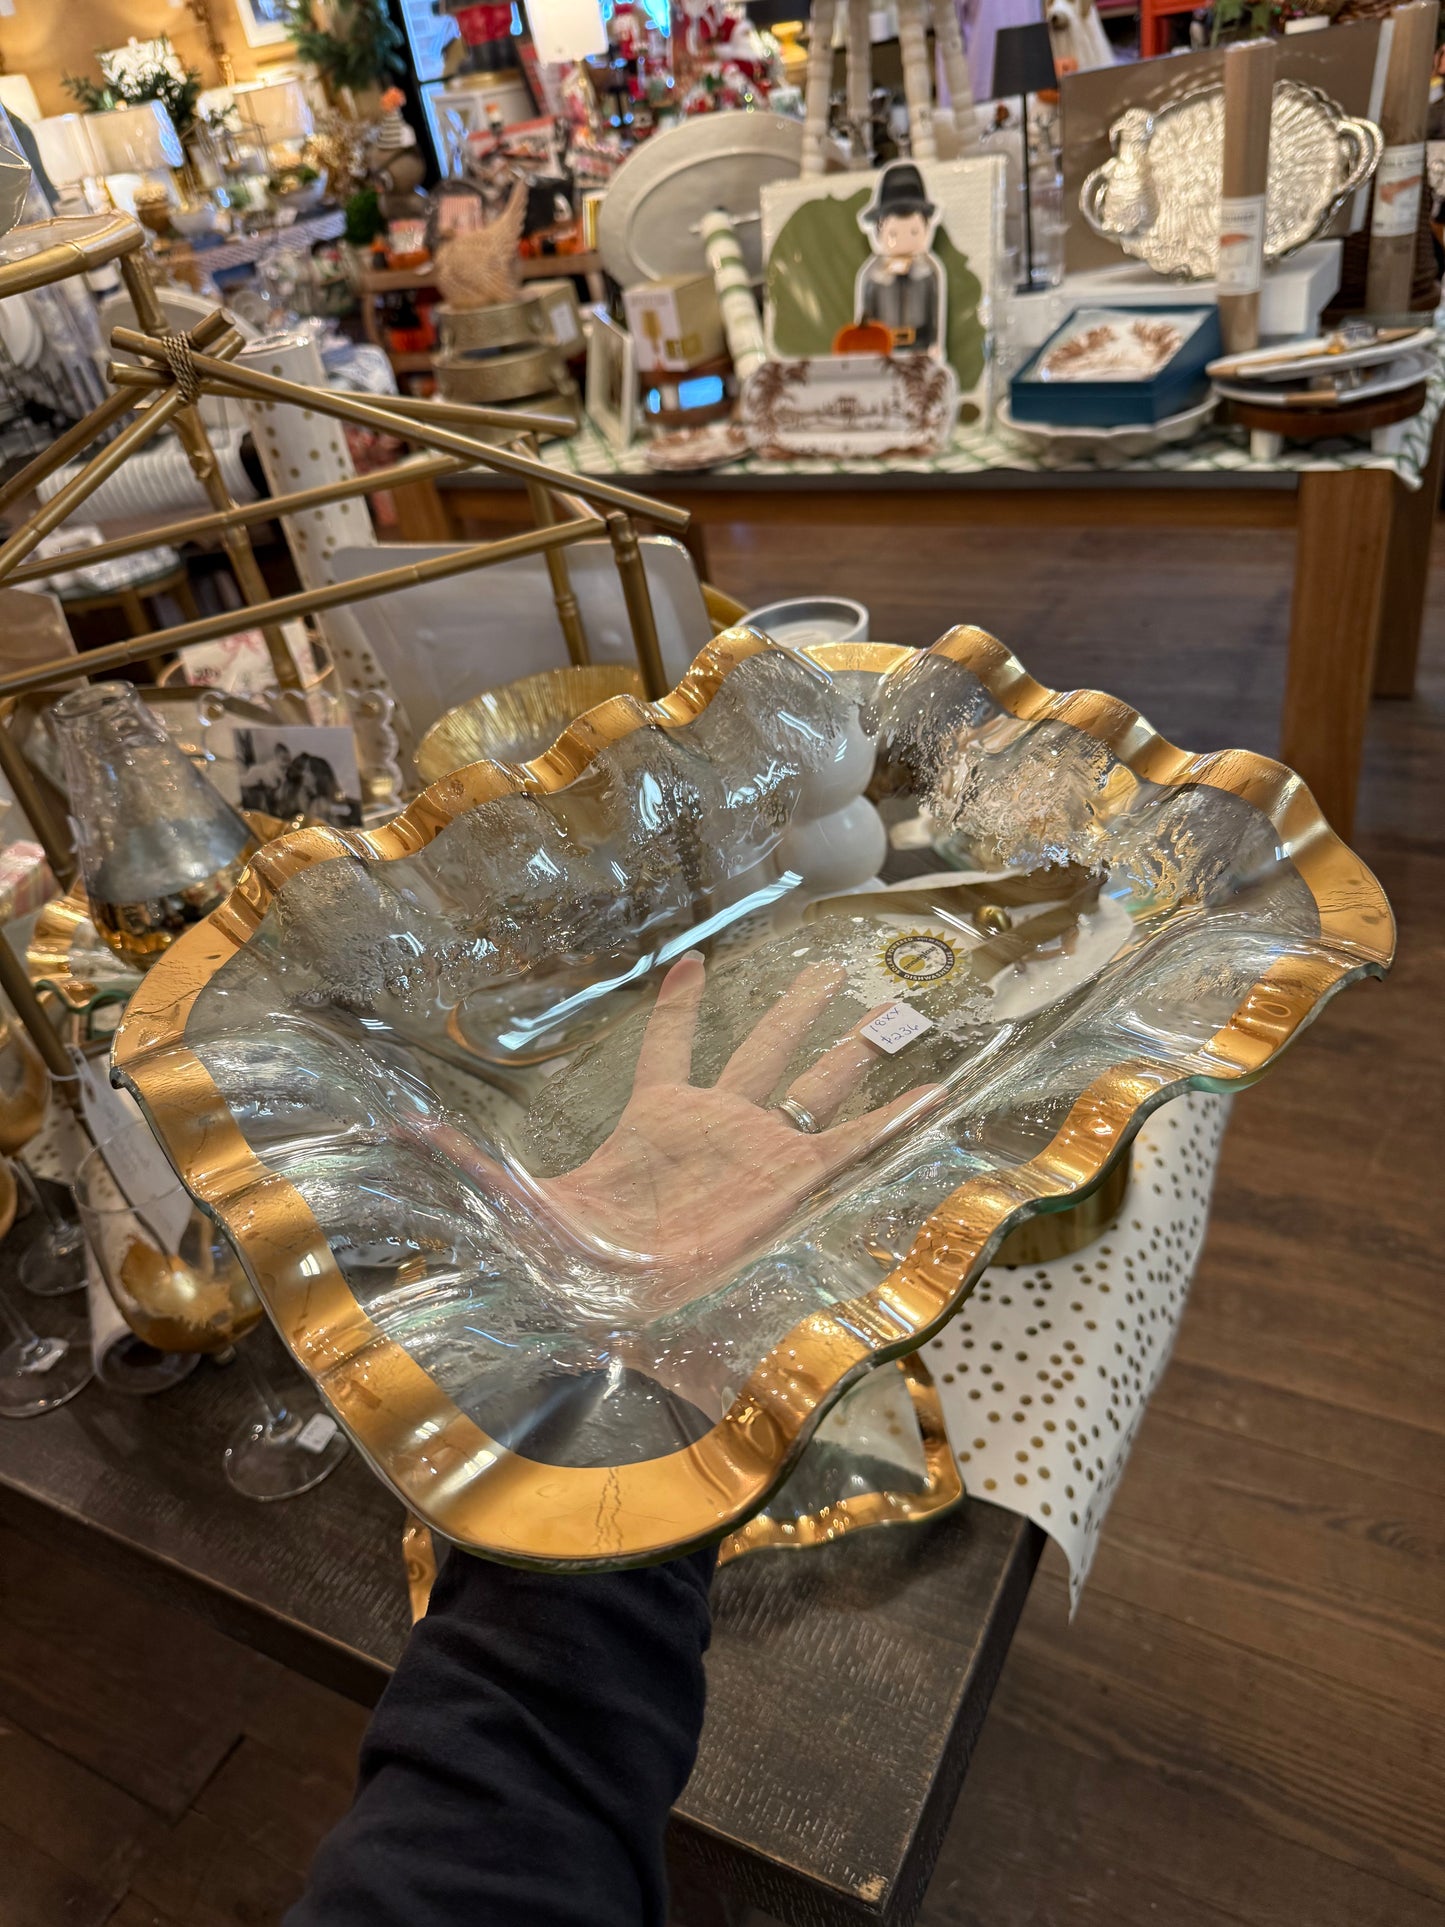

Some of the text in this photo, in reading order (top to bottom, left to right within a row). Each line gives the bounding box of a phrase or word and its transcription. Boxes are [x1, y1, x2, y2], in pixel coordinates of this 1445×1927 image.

[887, 937, 913, 956] POWERED
[903, 951, 953, 980] DISHWASHER SAFE
